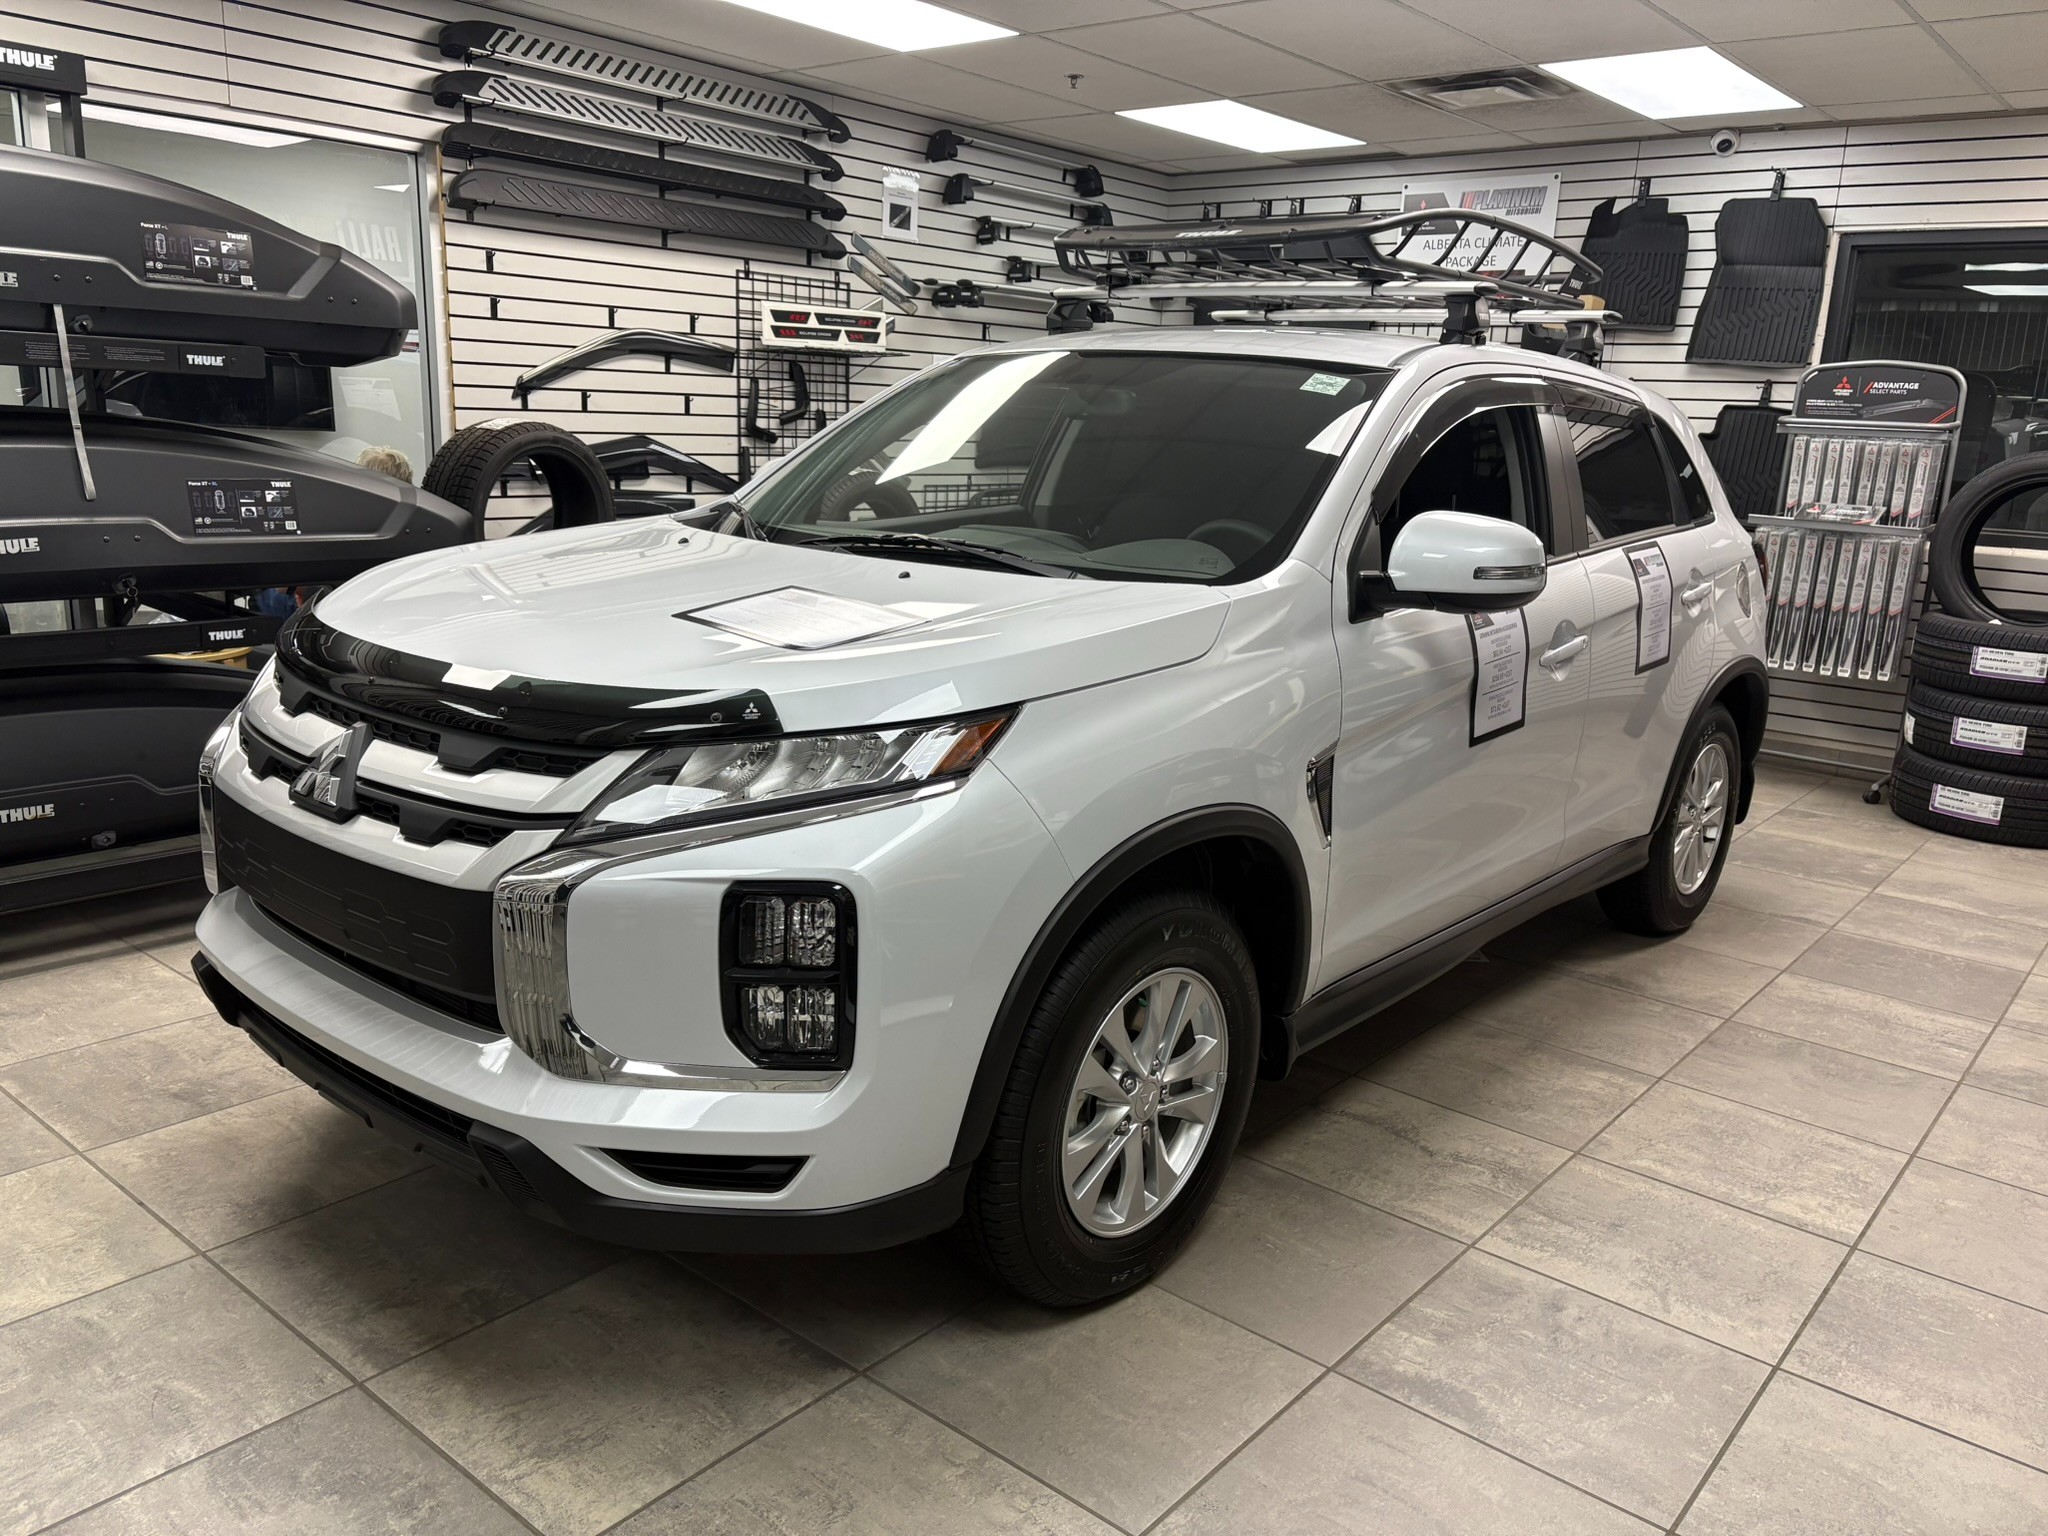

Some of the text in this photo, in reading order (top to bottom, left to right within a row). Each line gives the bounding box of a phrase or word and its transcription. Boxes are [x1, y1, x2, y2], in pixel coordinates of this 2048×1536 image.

[0, 46, 55, 71] THULE
[1472, 186, 1548, 210] PLATINUM
[1505, 207, 1542, 216] MITSUBISHI
[226, 232, 248, 240] THULE
[1175, 229, 1243, 238] THULE
[1423, 238, 1471, 250] ALBETA
[1445, 255, 1497, 267] PACKAGE
[187, 354, 224, 366] THULE
[1872, 381, 1920, 390] ADVANTAGE
[0, 537, 40, 554] ULE
[208, 630, 244, 641] THULE
[0, 804, 55, 824] THULE
